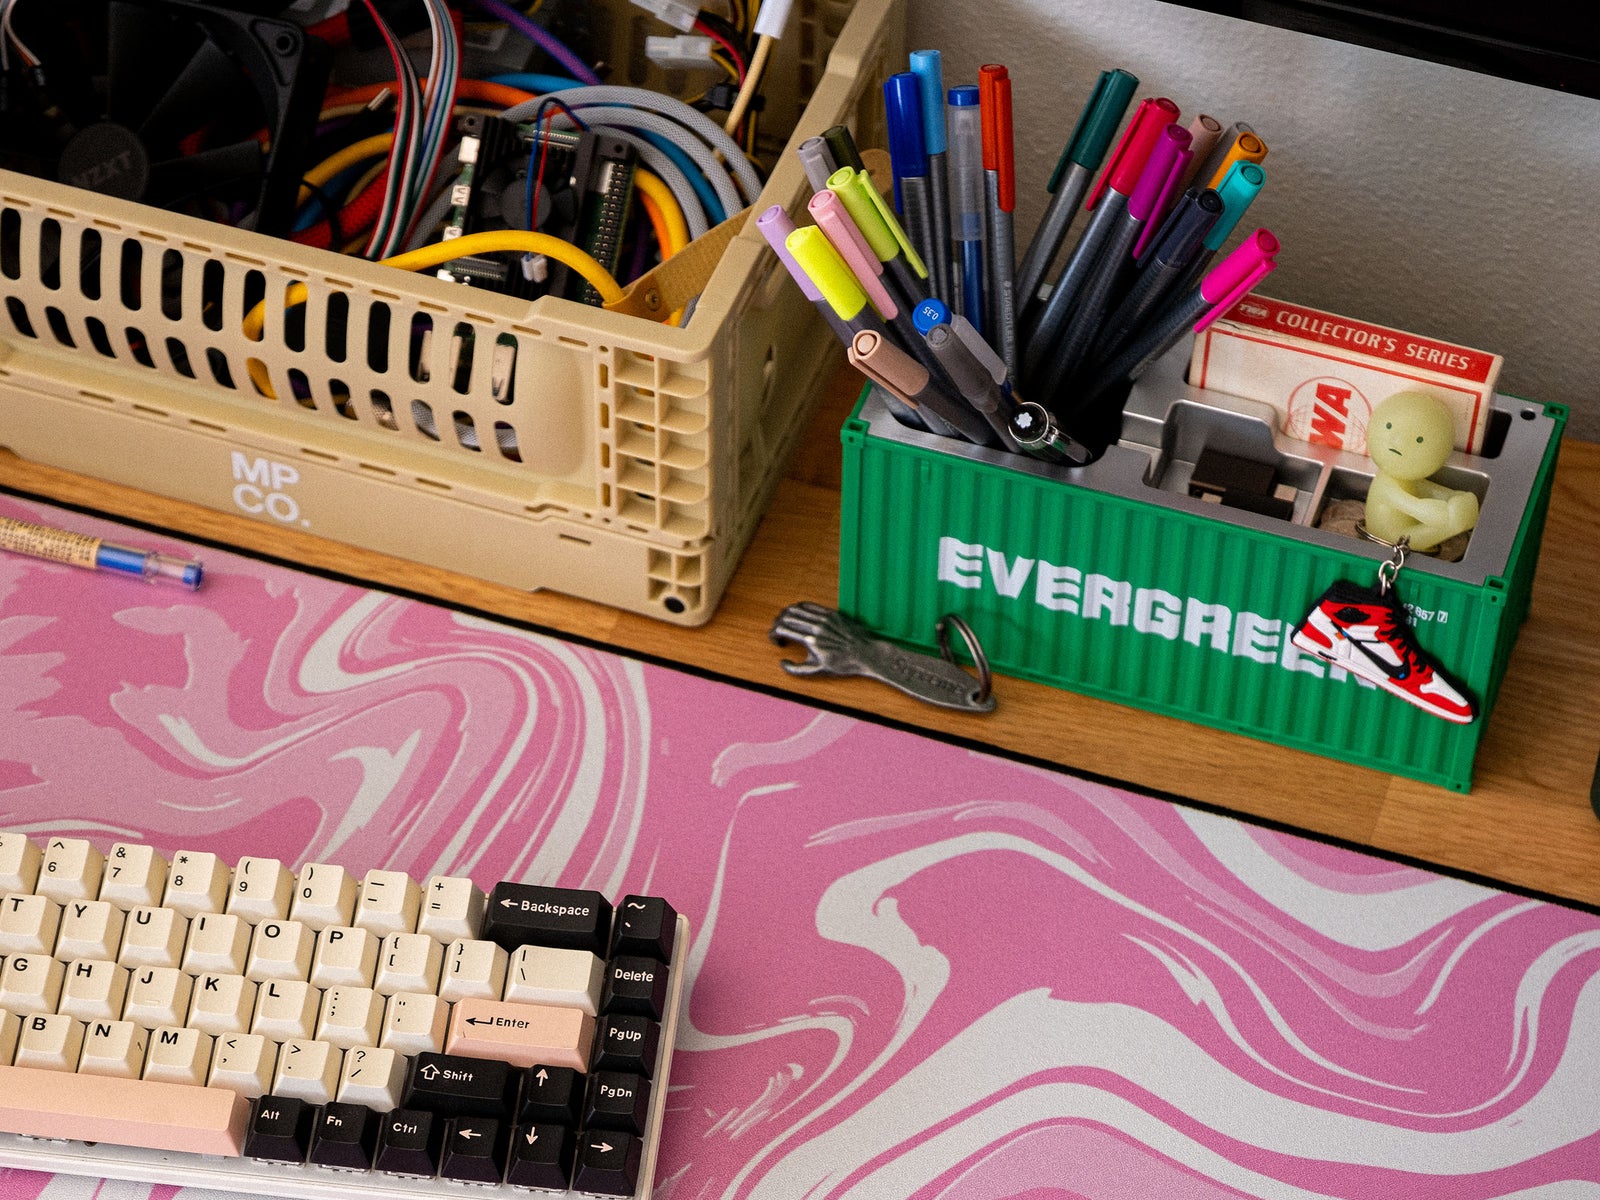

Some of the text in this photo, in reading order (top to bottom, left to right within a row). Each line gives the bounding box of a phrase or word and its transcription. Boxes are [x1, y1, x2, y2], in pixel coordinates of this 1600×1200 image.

[1003, 289, 1014, 343] STAEDTLER
[1238, 302, 1471, 371] TWA COLLECTOR'S SERIES
[1309, 382, 1353, 449] WA
[230, 450, 300, 491] MP
[231, 483, 311, 528] CO.
[937, 535, 1377, 691] EVERGREE
[115, 846, 126, 859] &
[47, 861, 57, 873] 6
[112, 866, 122, 878] 7
[174, 875, 184, 887] 8
[238, 881, 248, 893] 9
[302, 887, 312, 899] 0
[10, 897, 25, 912] T
[74, 903, 88, 918] Y
[520, 900, 590, 917] Backspace
[136, 910, 152, 925] U
[199, 917, 206, 931] I
[264, 924, 281, 939] O
[329, 930, 344, 944] P
[13, 957, 28, 972] G
[76, 962, 93, 978] H
[140, 970, 154, 985] J
[614, 968, 654, 982] Delete
[204, 976, 220, 992] K
[268, 982, 280, 998] L
[31, 1017, 47, 1031] B
[94, 1023, 112, 1038] N
[495, 1017, 530, 1029] Enter
[160, 1030, 179, 1045] M
[609, 1027, 642, 1042] PgUp
[356, 1050, 366, 1063] ?
[442, 1069, 473, 1082] Shift
[600, 1084, 633, 1098] PgDn
[260, 1109, 280, 1120] Alt
[326, 1115, 343, 1127] Fn
[392, 1122, 418, 1134] Ctrl
